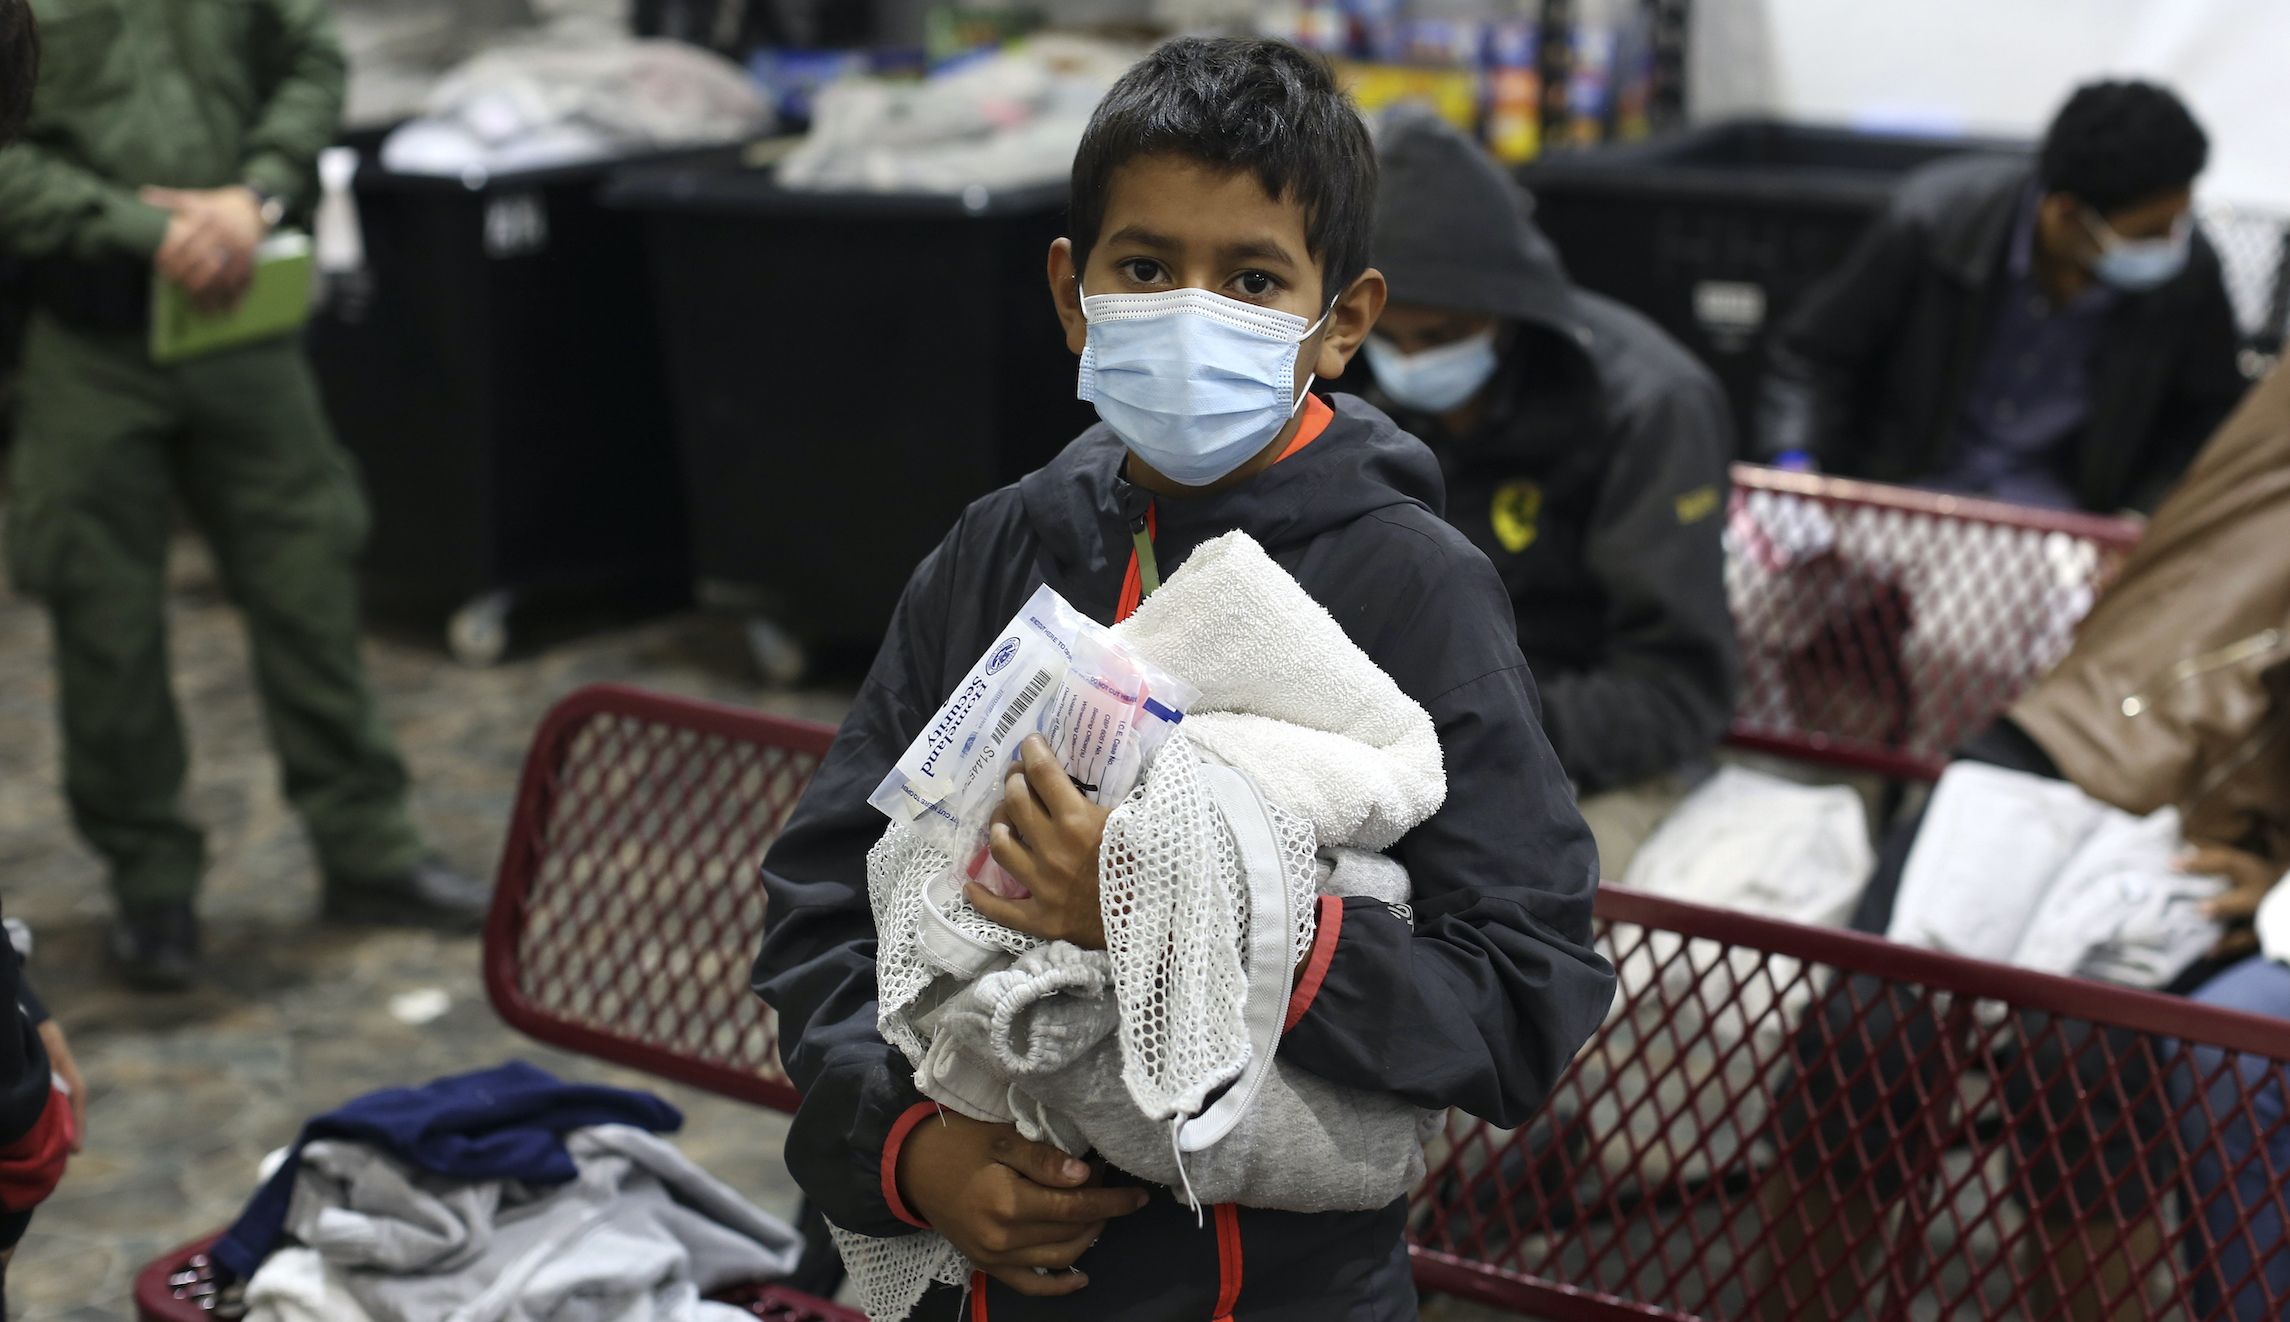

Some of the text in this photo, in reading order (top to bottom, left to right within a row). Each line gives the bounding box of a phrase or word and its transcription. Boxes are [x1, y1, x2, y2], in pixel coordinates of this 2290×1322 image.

[1043, 629, 1059, 643] HERE
[1056, 640, 1067, 650] TO
[1090, 676, 1097, 685] DO
[1097, 681, 1109, 691] NOT
[1108, 687, 1121, 697] CUT
[928, 675, 983, 748] Security
[1056, 687, 1070, 717] Date/Time
[1067, 694, 1078, 717] Violator
[1073, 700, 1088, 734] Witnessing
[920, 682, 988, 778] Homeland
[1079, 707, 1099, 759] Seizing Officer(s)
[1094, 714, 1111, 756] CBP 6051 No.
[1107, 720, 1126, 767] I.C.E. Case No.
[912, 793, 922, 802] TO
[920, 798, 938, 811] HERE
[937, 808, 951, 819] CUT
